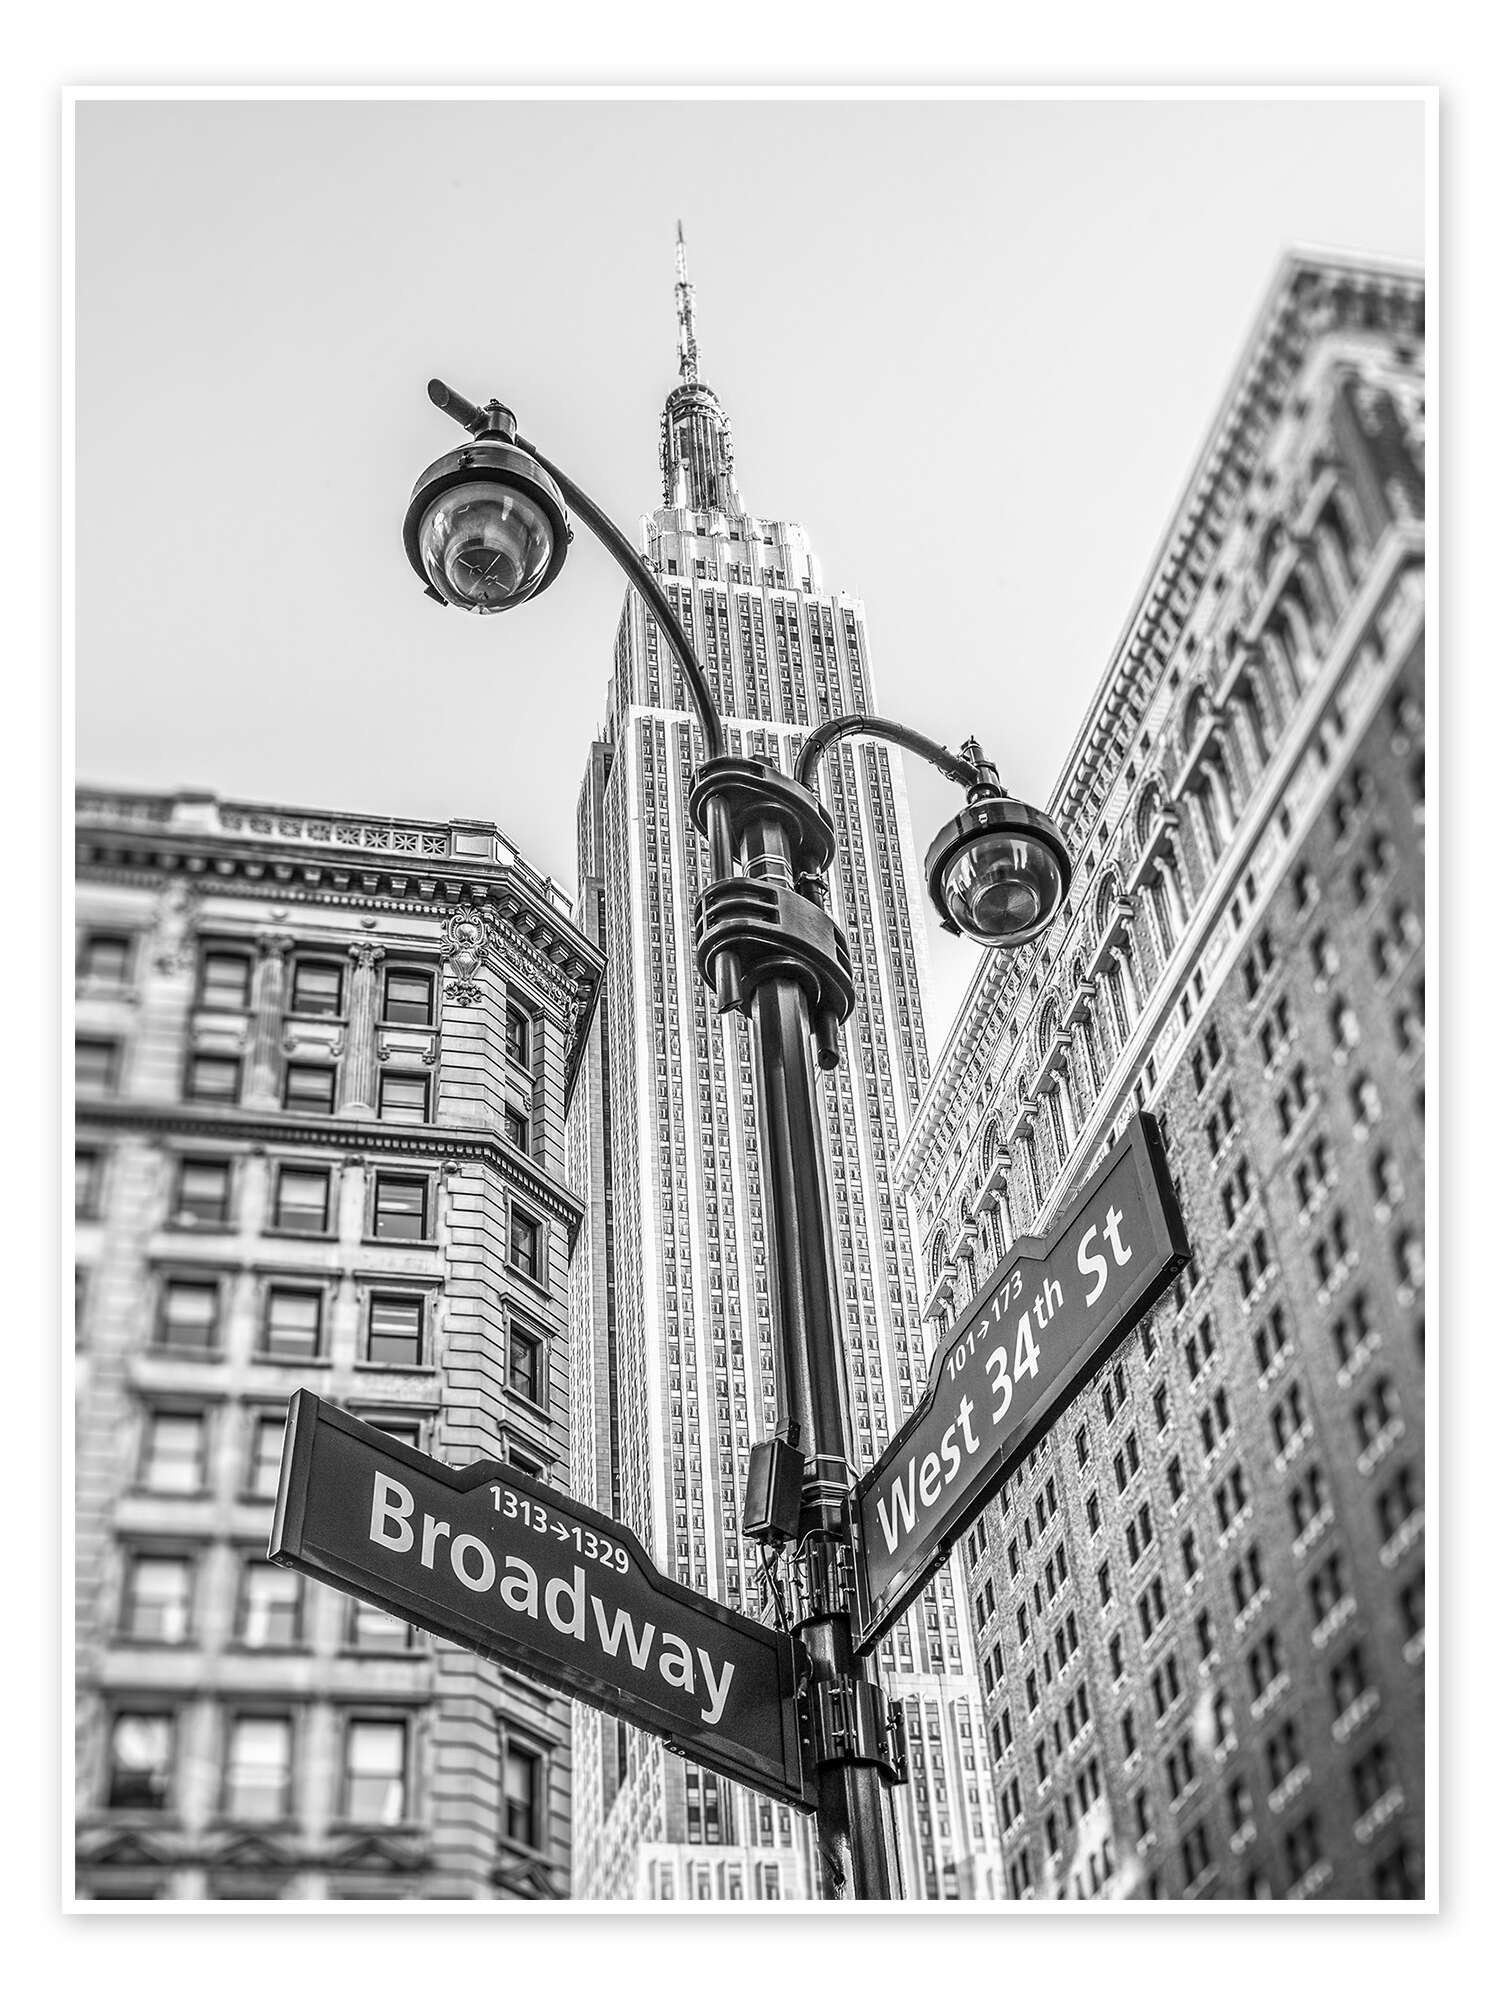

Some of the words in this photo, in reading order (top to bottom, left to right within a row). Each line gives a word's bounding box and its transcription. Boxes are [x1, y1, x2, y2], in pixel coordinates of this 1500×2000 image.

[876, 1393, 981, 1556] West
[984, 1277, 1065, 1426] 34th
[1076, 1204, 1133, 1309] St
[946, 1336, 975, 1383] 101
[991, 1270, 1023, 1322] 173
[368, 1469, 736, 1725] Broadway
[489, 1485, 548, 1533] 1313
[571, 1525, 630, 1575] 1329
